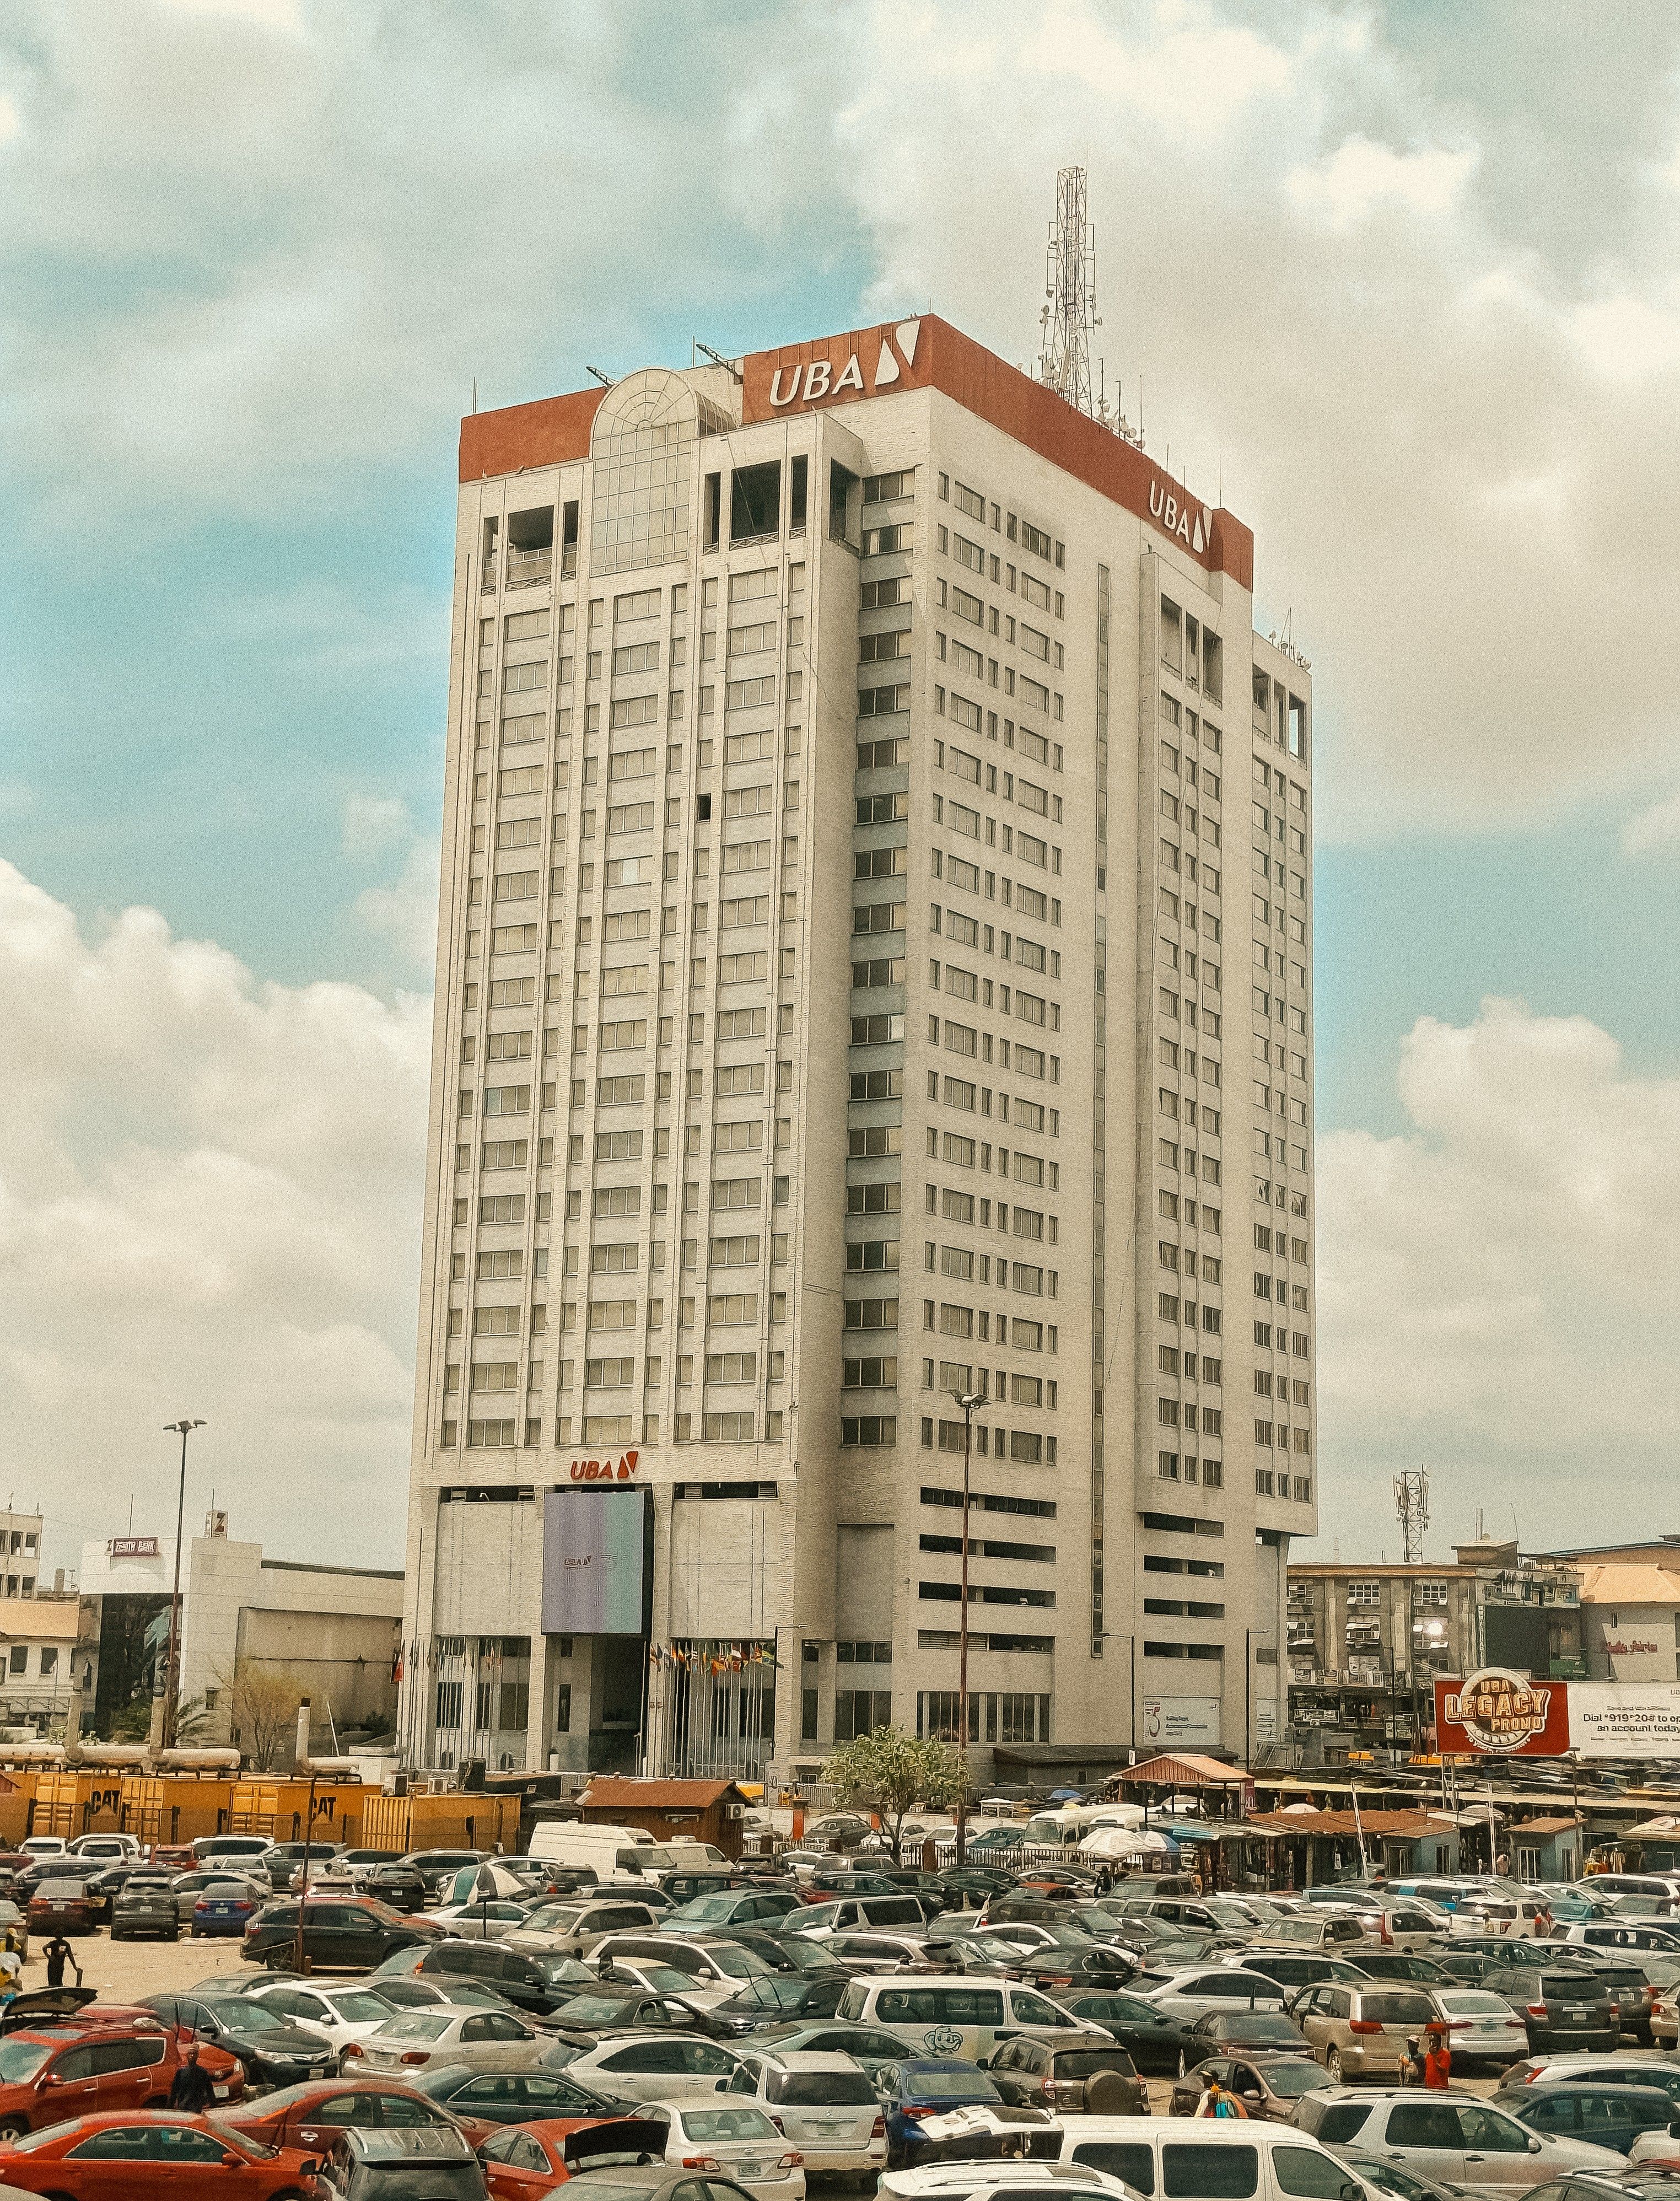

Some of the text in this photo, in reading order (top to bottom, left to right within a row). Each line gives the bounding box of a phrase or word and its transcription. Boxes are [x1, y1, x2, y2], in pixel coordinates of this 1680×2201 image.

[769, 353, 864, 407] UBA
[1149, 480, 1189, 544] UBA
[570, 1460, 613, 1480] UBA
[1480, 1680, 1510, 1693] UBA
[1446, 1690, 1547, 1719] LEGACY
[1491, 1716, 1541, 1731] PROMO
[1654, 1724, 1680, 1734] today
[91, 1790, 120, 1815] CAT
